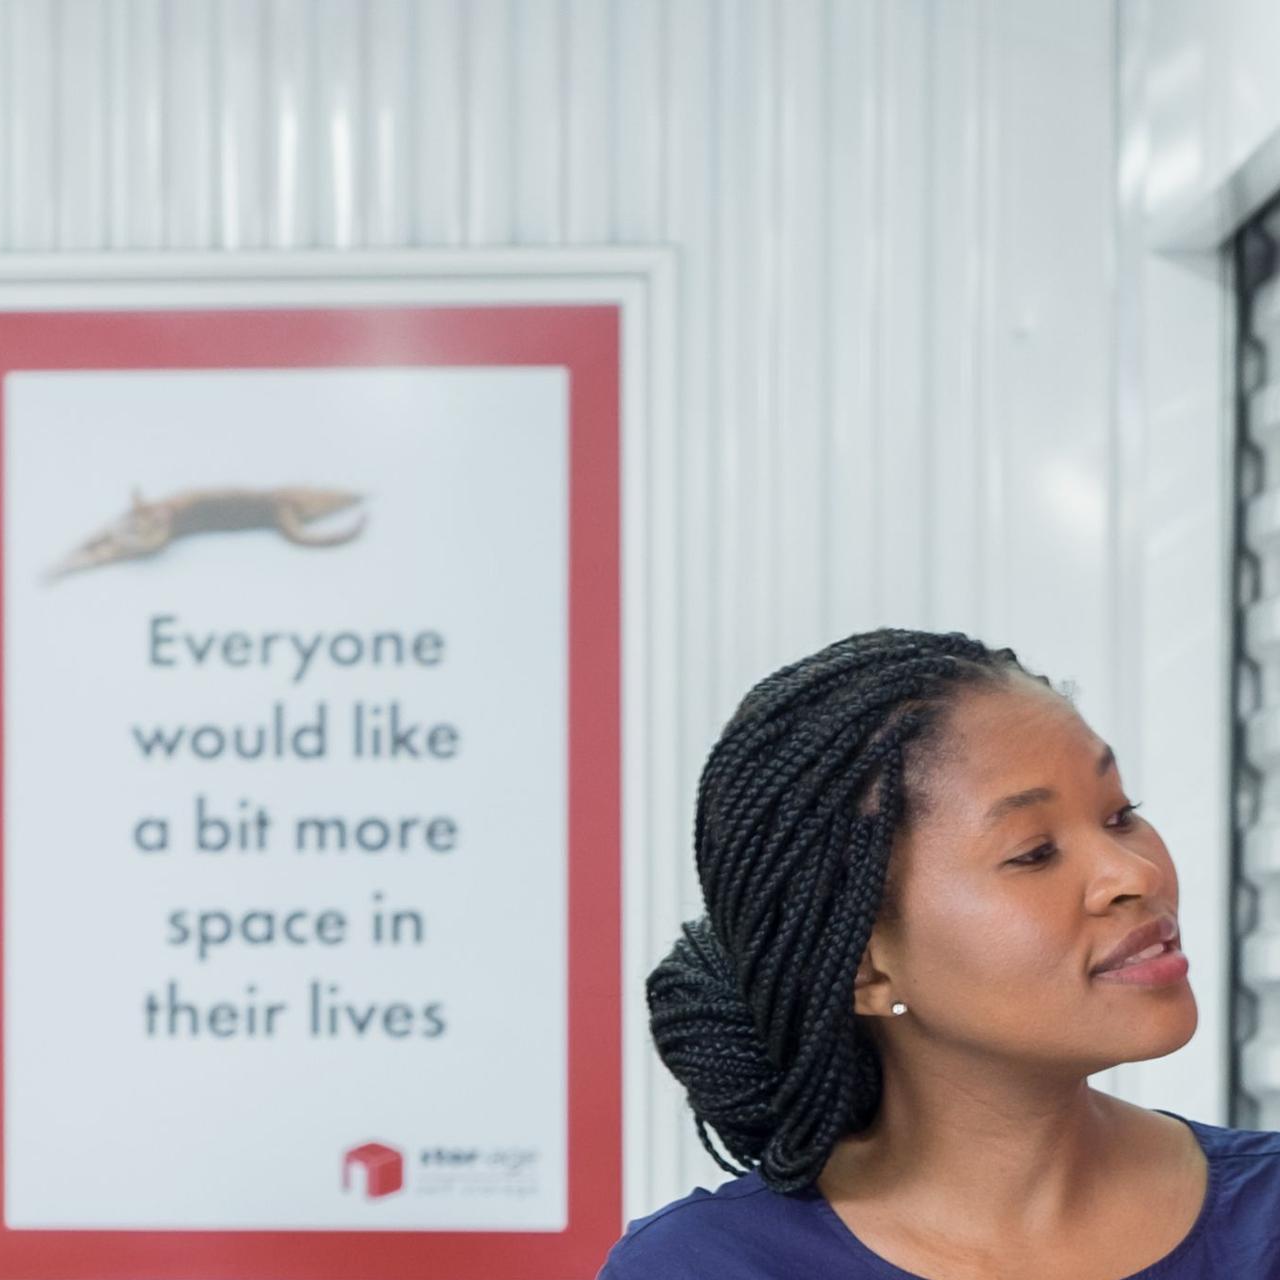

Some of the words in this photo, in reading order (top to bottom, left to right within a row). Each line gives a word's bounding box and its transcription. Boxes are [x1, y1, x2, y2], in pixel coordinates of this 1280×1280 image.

[148, 616, 446, 682] Everyone
[132, 702, 328, 761] would
[353, 702, 461, 761] like
[133, 813, 170, 854] a
[195, 795, 271, 854] bit
[295, 812, 461, 854] more
[167, 906, 348, 959] space
[373, 892, 425, 946] in
[144, 981, 286, 1039] their
[310, 981, 447, 1039] lives
